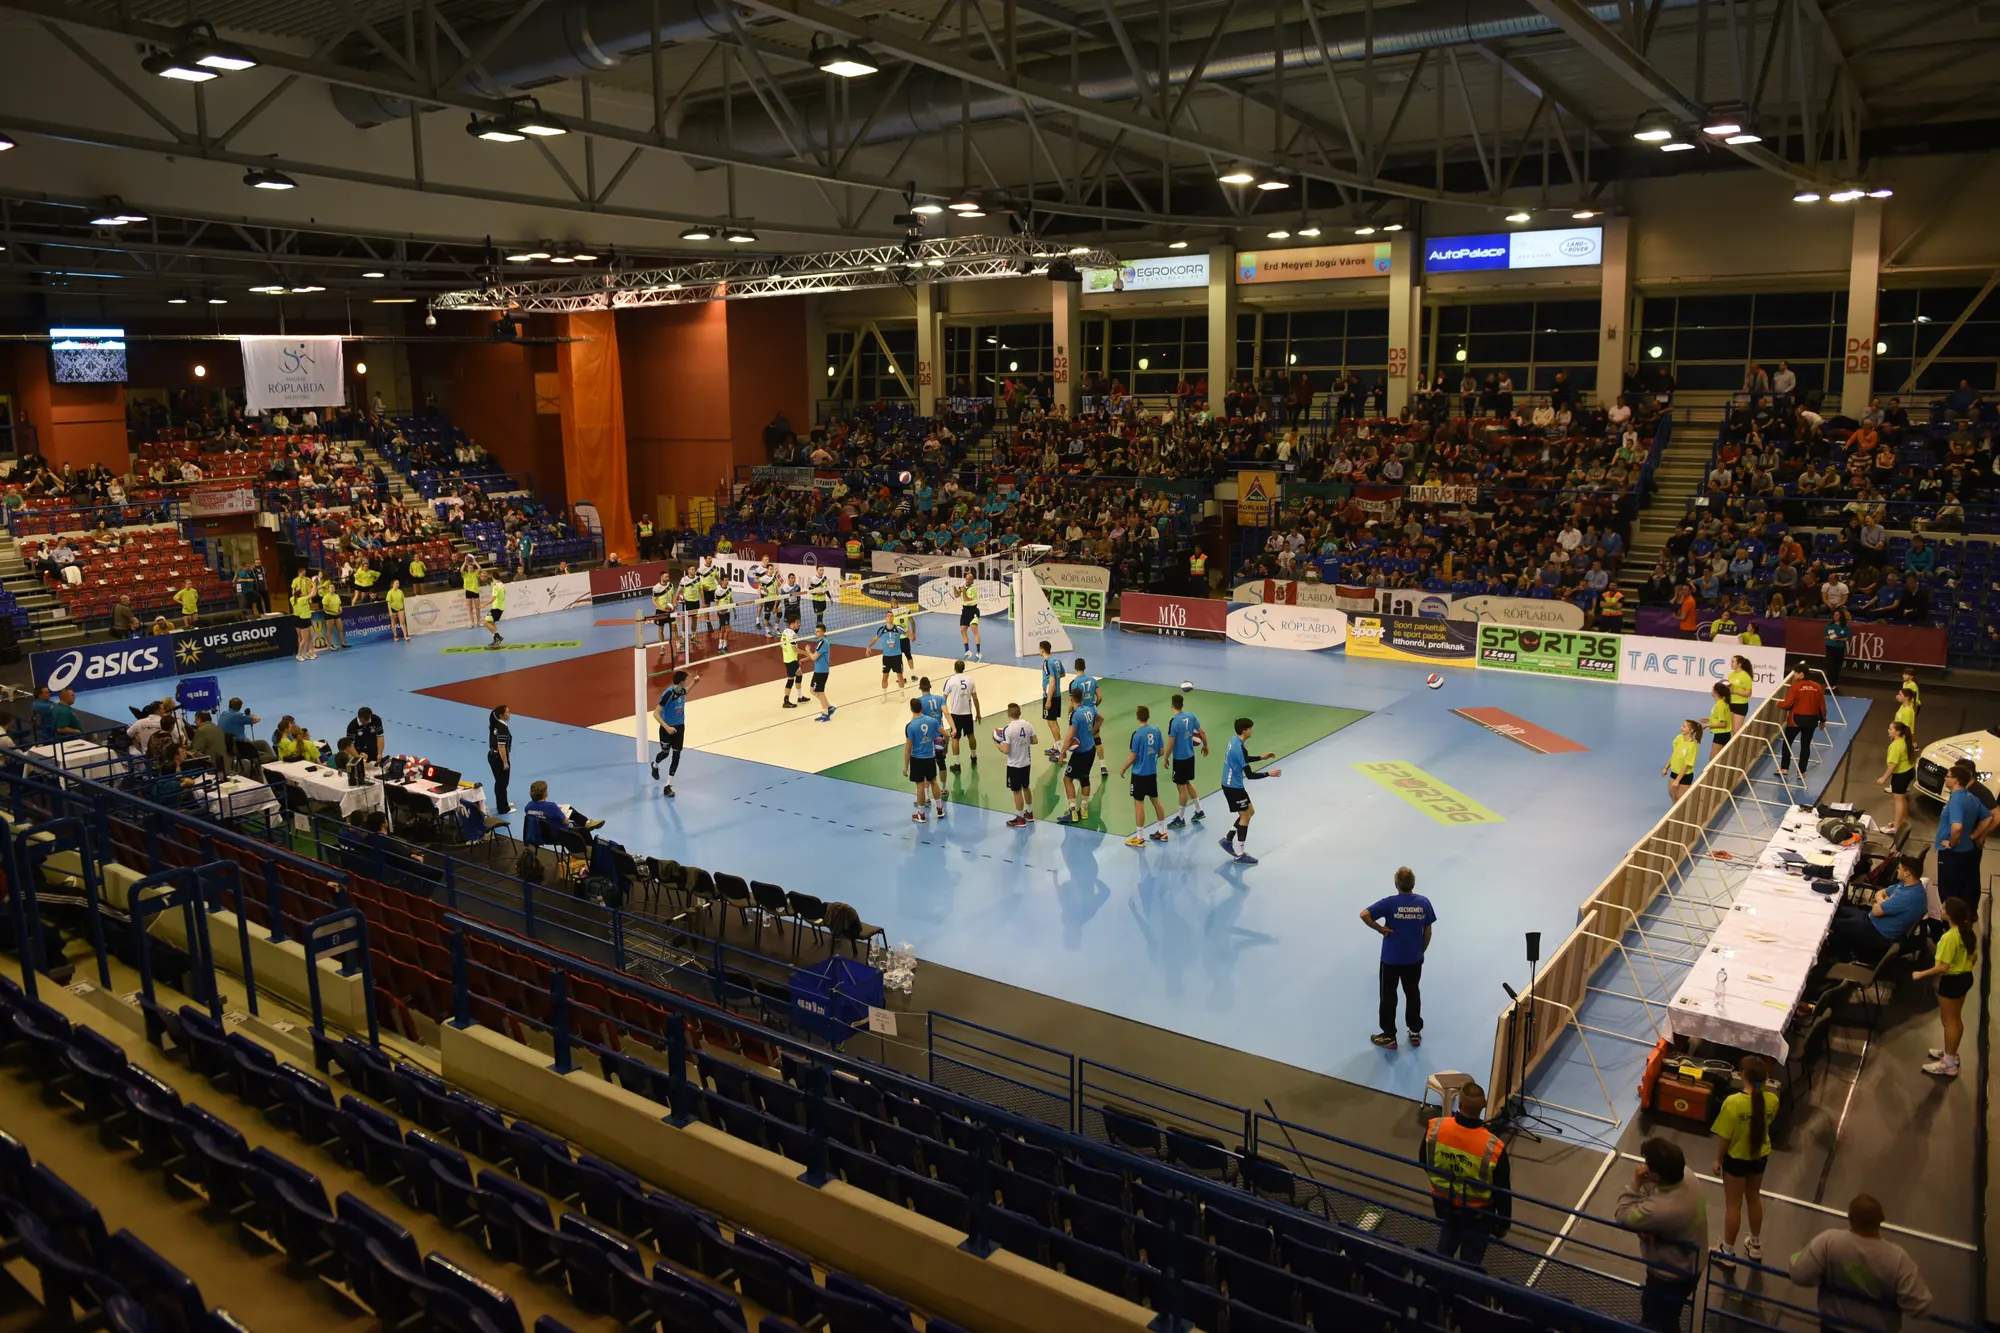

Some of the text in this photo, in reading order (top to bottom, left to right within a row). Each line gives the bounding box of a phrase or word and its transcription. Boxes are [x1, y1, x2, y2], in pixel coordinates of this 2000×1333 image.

[1429, 247, 1506, 261] AutoPalace
[1264, 256, 1366, 270] Érd Megyei Jogú Város
[1137, 264, 1204, 277] EGROKORR
[1848, 338, 1872, 353] D4
[1389, 347, 1407, 361] D3
[919, 361, 931, 372] D1
[1054, 357, 1067, 369] D2
[1389, 362, 1407, 376] D7
[1846, 355, 1870, 370] D8
[919, 373, 931, 383] D5
[1054, 370, 1067, 380] D6
[268, 382, 325, 394] RÖPLABDA
[620, 570, 642, 591] MKB
[1060, 573, 1104, 585] RÖPLABDA
[622, 590, 643, 599] BANK
[1042, 588, 1101, 610] RT36
[1296, 593, 1336, 604] PLABDA
[1158, 603, 1187, 628] MKB
[1503, 607, 1565, 623] RÖPLABDA
[1158, 627, 1186, 637] BANK
[1281, 620, 1338, 634] RÖPLABDA
[1350, 626, 1386, 639] sport
[1393, 620, 1447, 632] Sport parketták
[203, 626, 277, 647] UFS GROUP
[1403, 631, 1421, 639] sport
[1422, 632, 1447, 641] padlók
[1392, 637, 1427, 648] itthonról,
[1428, 641, 1466, 651] profiknak
[1846, 631, 1884, 661] MKB
[1490, 650, 1516, 659] Zeus
[85, 647, 159, 680] asics
[1587, 659, 1614, 669] Zeus
[1628, 650, 1725, 679] TACTIC
[1842, 661, 1882, 672] BANK
[1752, 671, 1776, 684] ort
[960, 679, 968, 691] 5
[1080, 680, 1091, 692] 17
[928, 698, 938, 711] 11
[1083, 710, 1094, 724] 10
[1183, 717, 1189, 730] 7
[920, 723, 929, 736] 9
[1019, 727, 1027, 739] 4
[1147, 733, 1155, 746] 8
